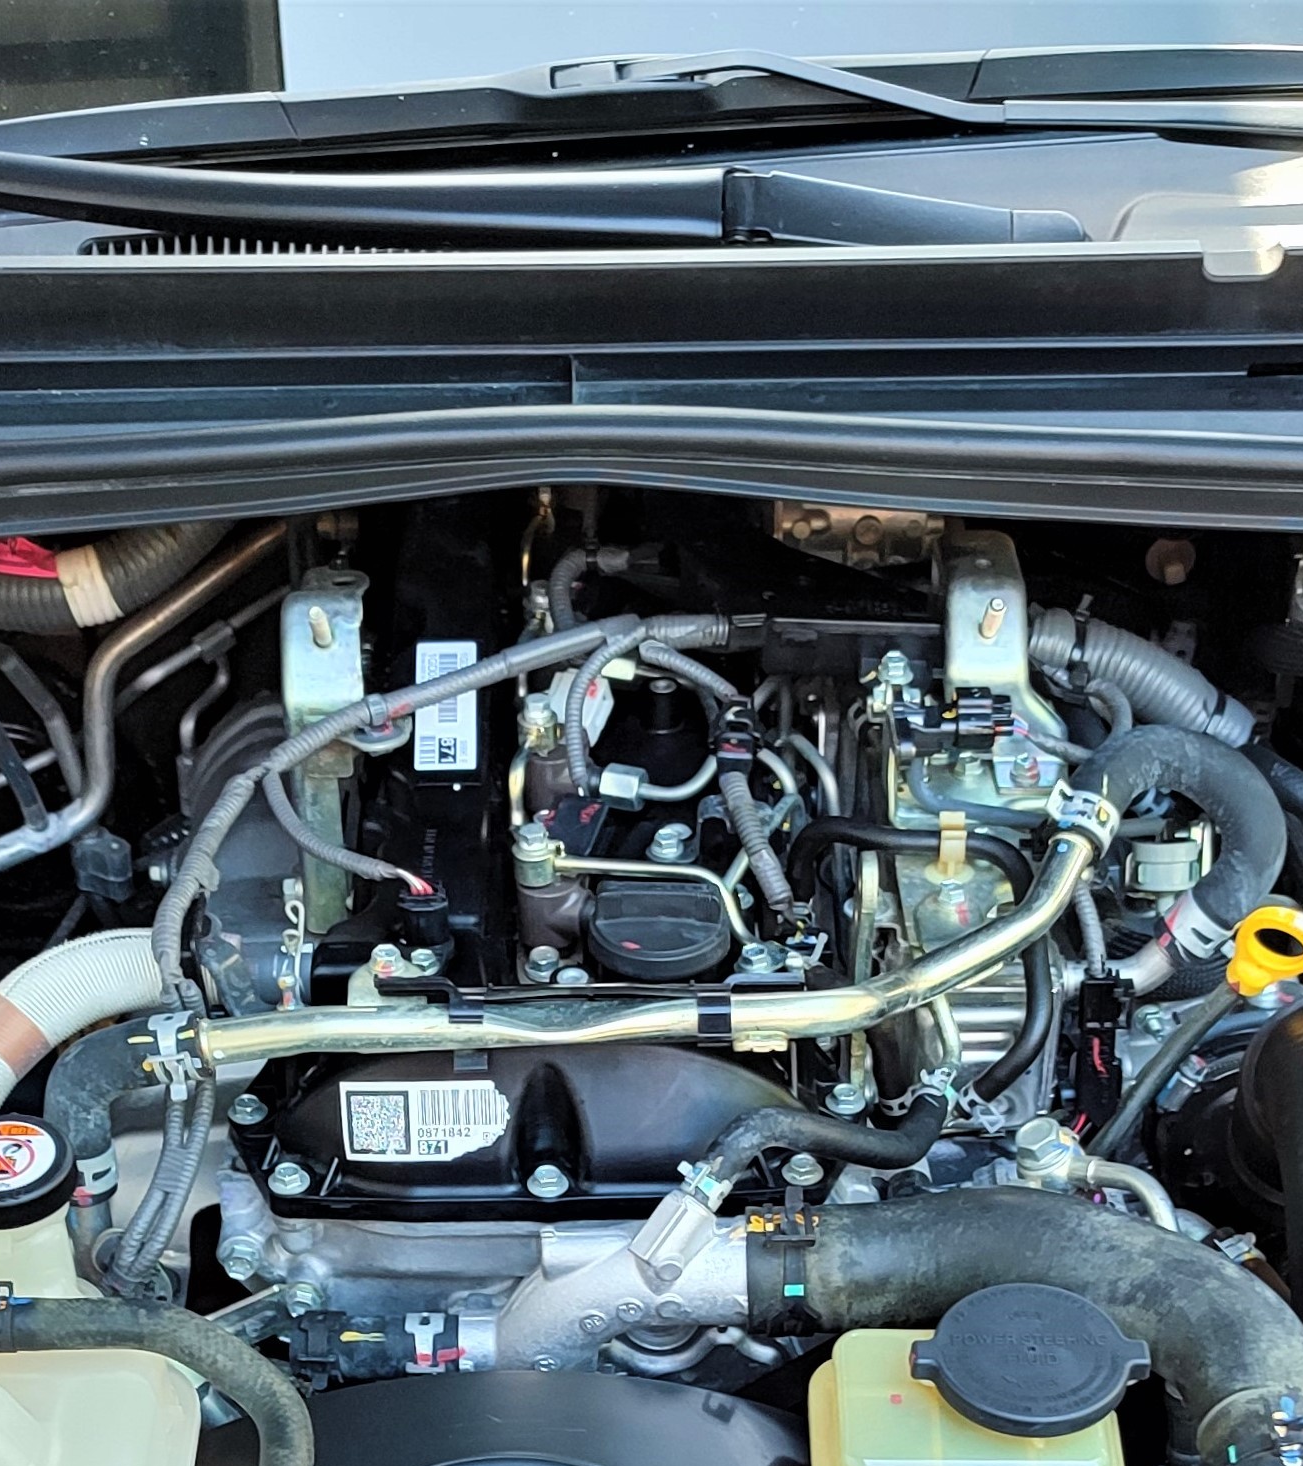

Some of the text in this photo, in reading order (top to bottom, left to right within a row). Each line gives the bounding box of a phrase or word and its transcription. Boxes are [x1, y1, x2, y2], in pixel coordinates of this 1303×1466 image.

[439, 738, 456, 764] 871
[417, 1127, 471, 1139] 0871842
[418, 1140, 448, 1155] 871
[949, 1333, 1108, 1347] POWER STEERING
[1005, 1352, 1060, 1366] FLUID
